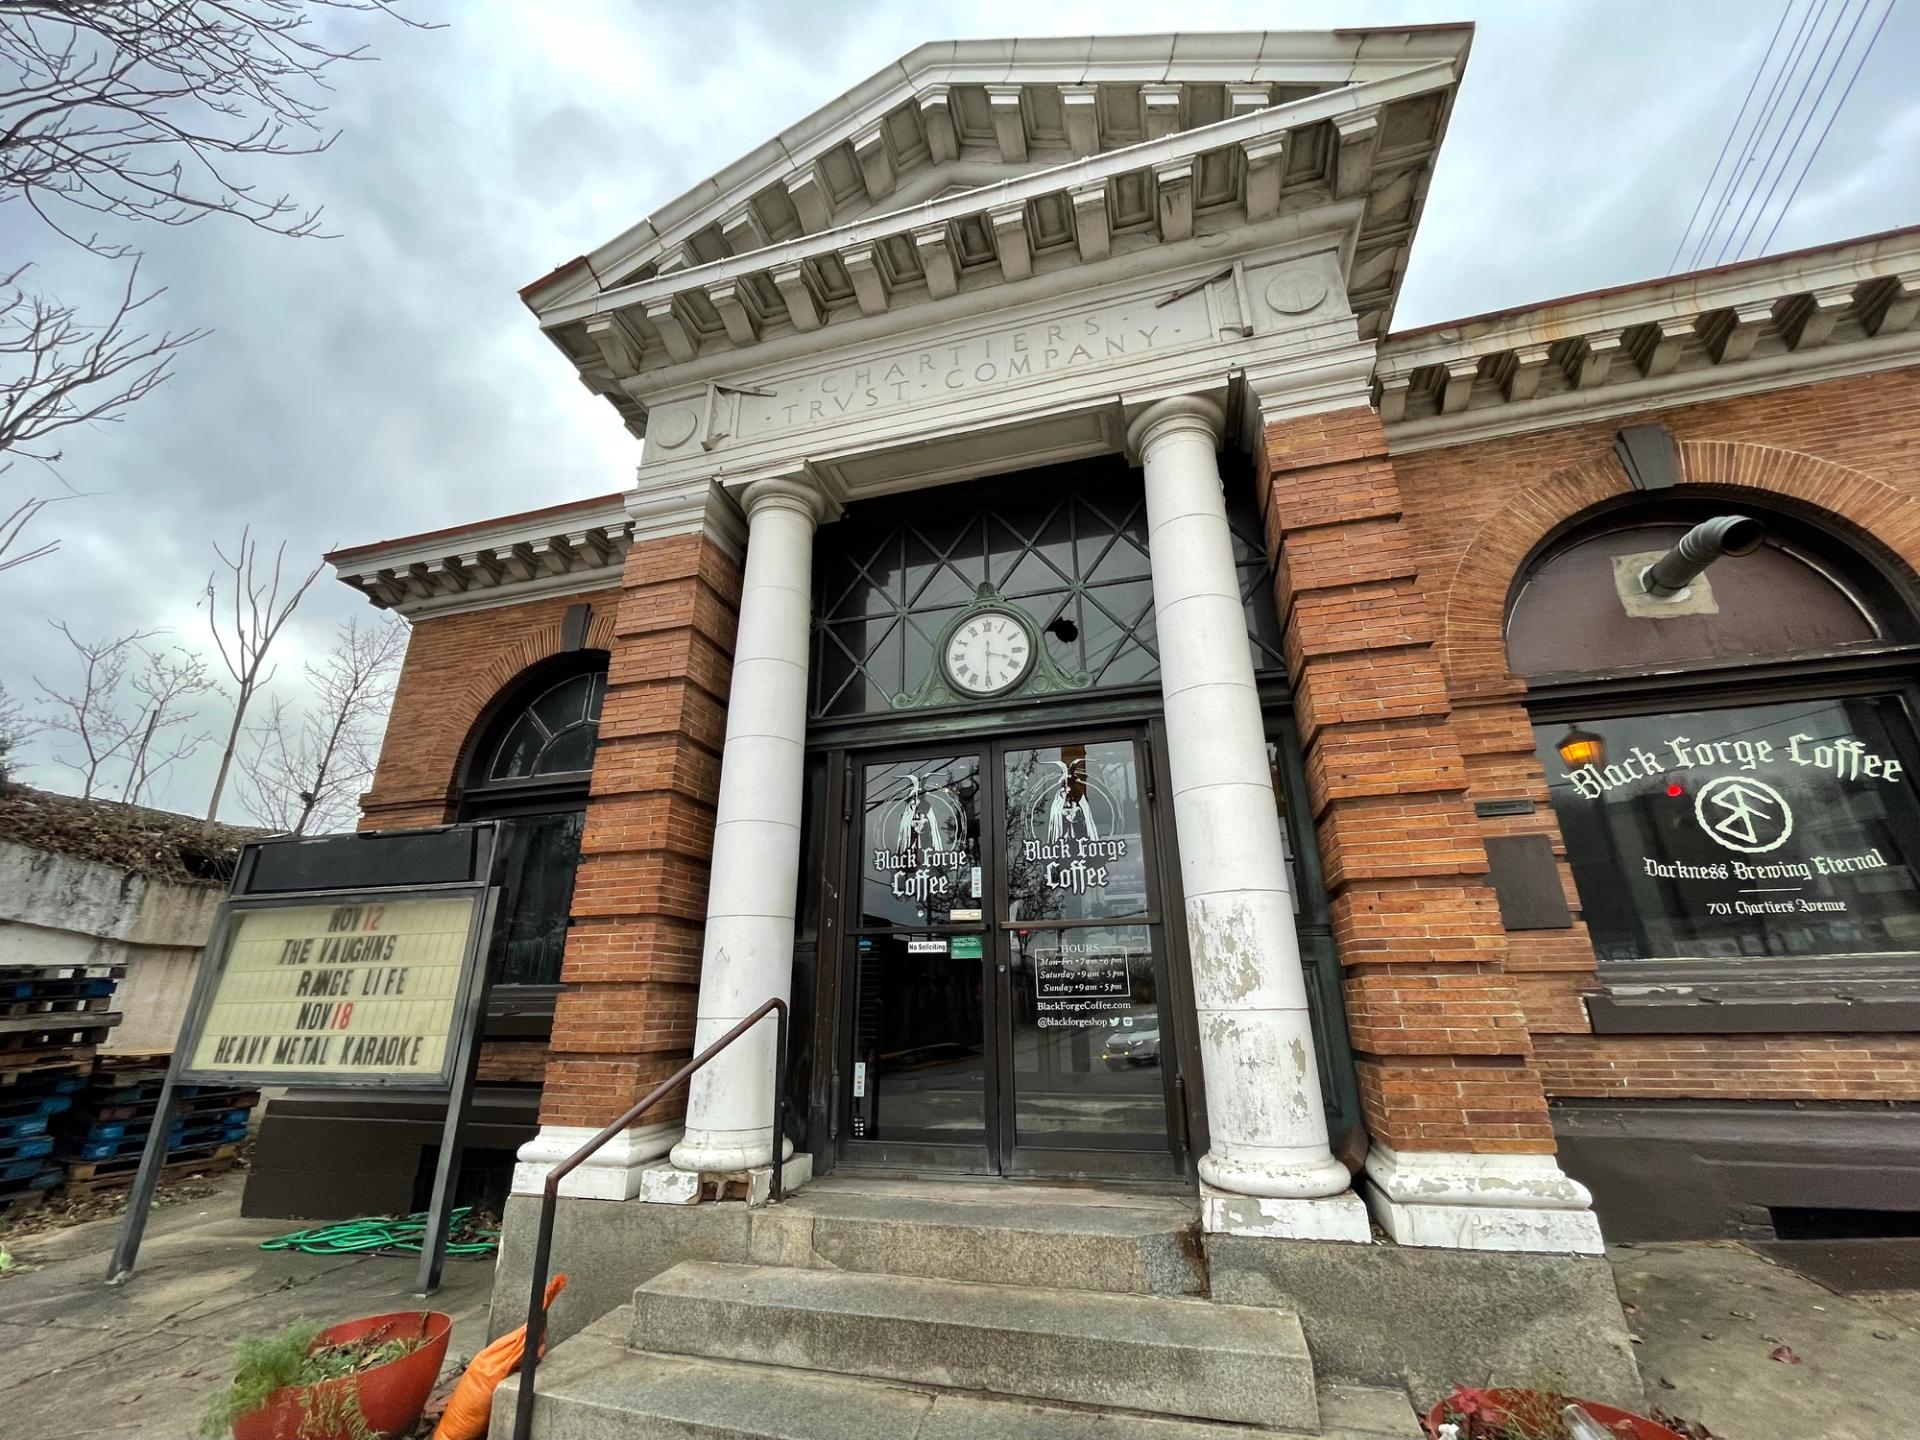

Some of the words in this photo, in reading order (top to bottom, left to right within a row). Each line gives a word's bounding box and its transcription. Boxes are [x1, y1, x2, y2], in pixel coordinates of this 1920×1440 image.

[821, 317, 1100, 394] CHARTIERS
[945, 326, 1160, 390] COMPANY
[1561, 747, 1665, 799] Black
[1664, 736, 1773, 770] Forge
[1787, 733, 1903, 782] Coffee
[874, 850, 918, 871] Black
[921, 848, 967, 871] Forge
[1024, 839, 1070, 861] Black
[1075, 837, 1127, 863] Forge
[1044, 860, 1109, 894] Coffee
[1642, 857, 1728, 880] Darkness
[1731, 859, 1812, 881] Brewing
[1810, 849, 1887, 876] Eternal
[891, 869, 949, 901] Coffee
[328, 907, 362, 933] NOV
[362, 905, 385, 932] 12
[1707, 902, 1732, 915] 701
[1734, 899, 1795, 916] Chartiers
[1796, 898, 1848, 912] Avenue
[280, 938, 314, 965] THE
[318, 935, 397, 964] VAUGHNS
[918, 942, 946, 951] Soliciting
[1061, 944, 1100, 953] HOURS
[296, 969, 354, 997] RANGE
[362, 967, 409, 996] LIFE
[1040, 970, 1075, 979] Saturday
[1043, 983, 1073, 992] Sunday
[296, 1002, 332, 1030] NOV
[330, 1002, 354, 1030] 18
[1037, 1001, 1131, 1011] BlackForgeCoffee.com
[1037, 1017, 1108, 1028] @blackforgeshop
[213, 1036, 270, 1064] HEAVY
[273, 1036, 330, 1065] METAL
[339, 1036, 424, 1066] KARAOKE
